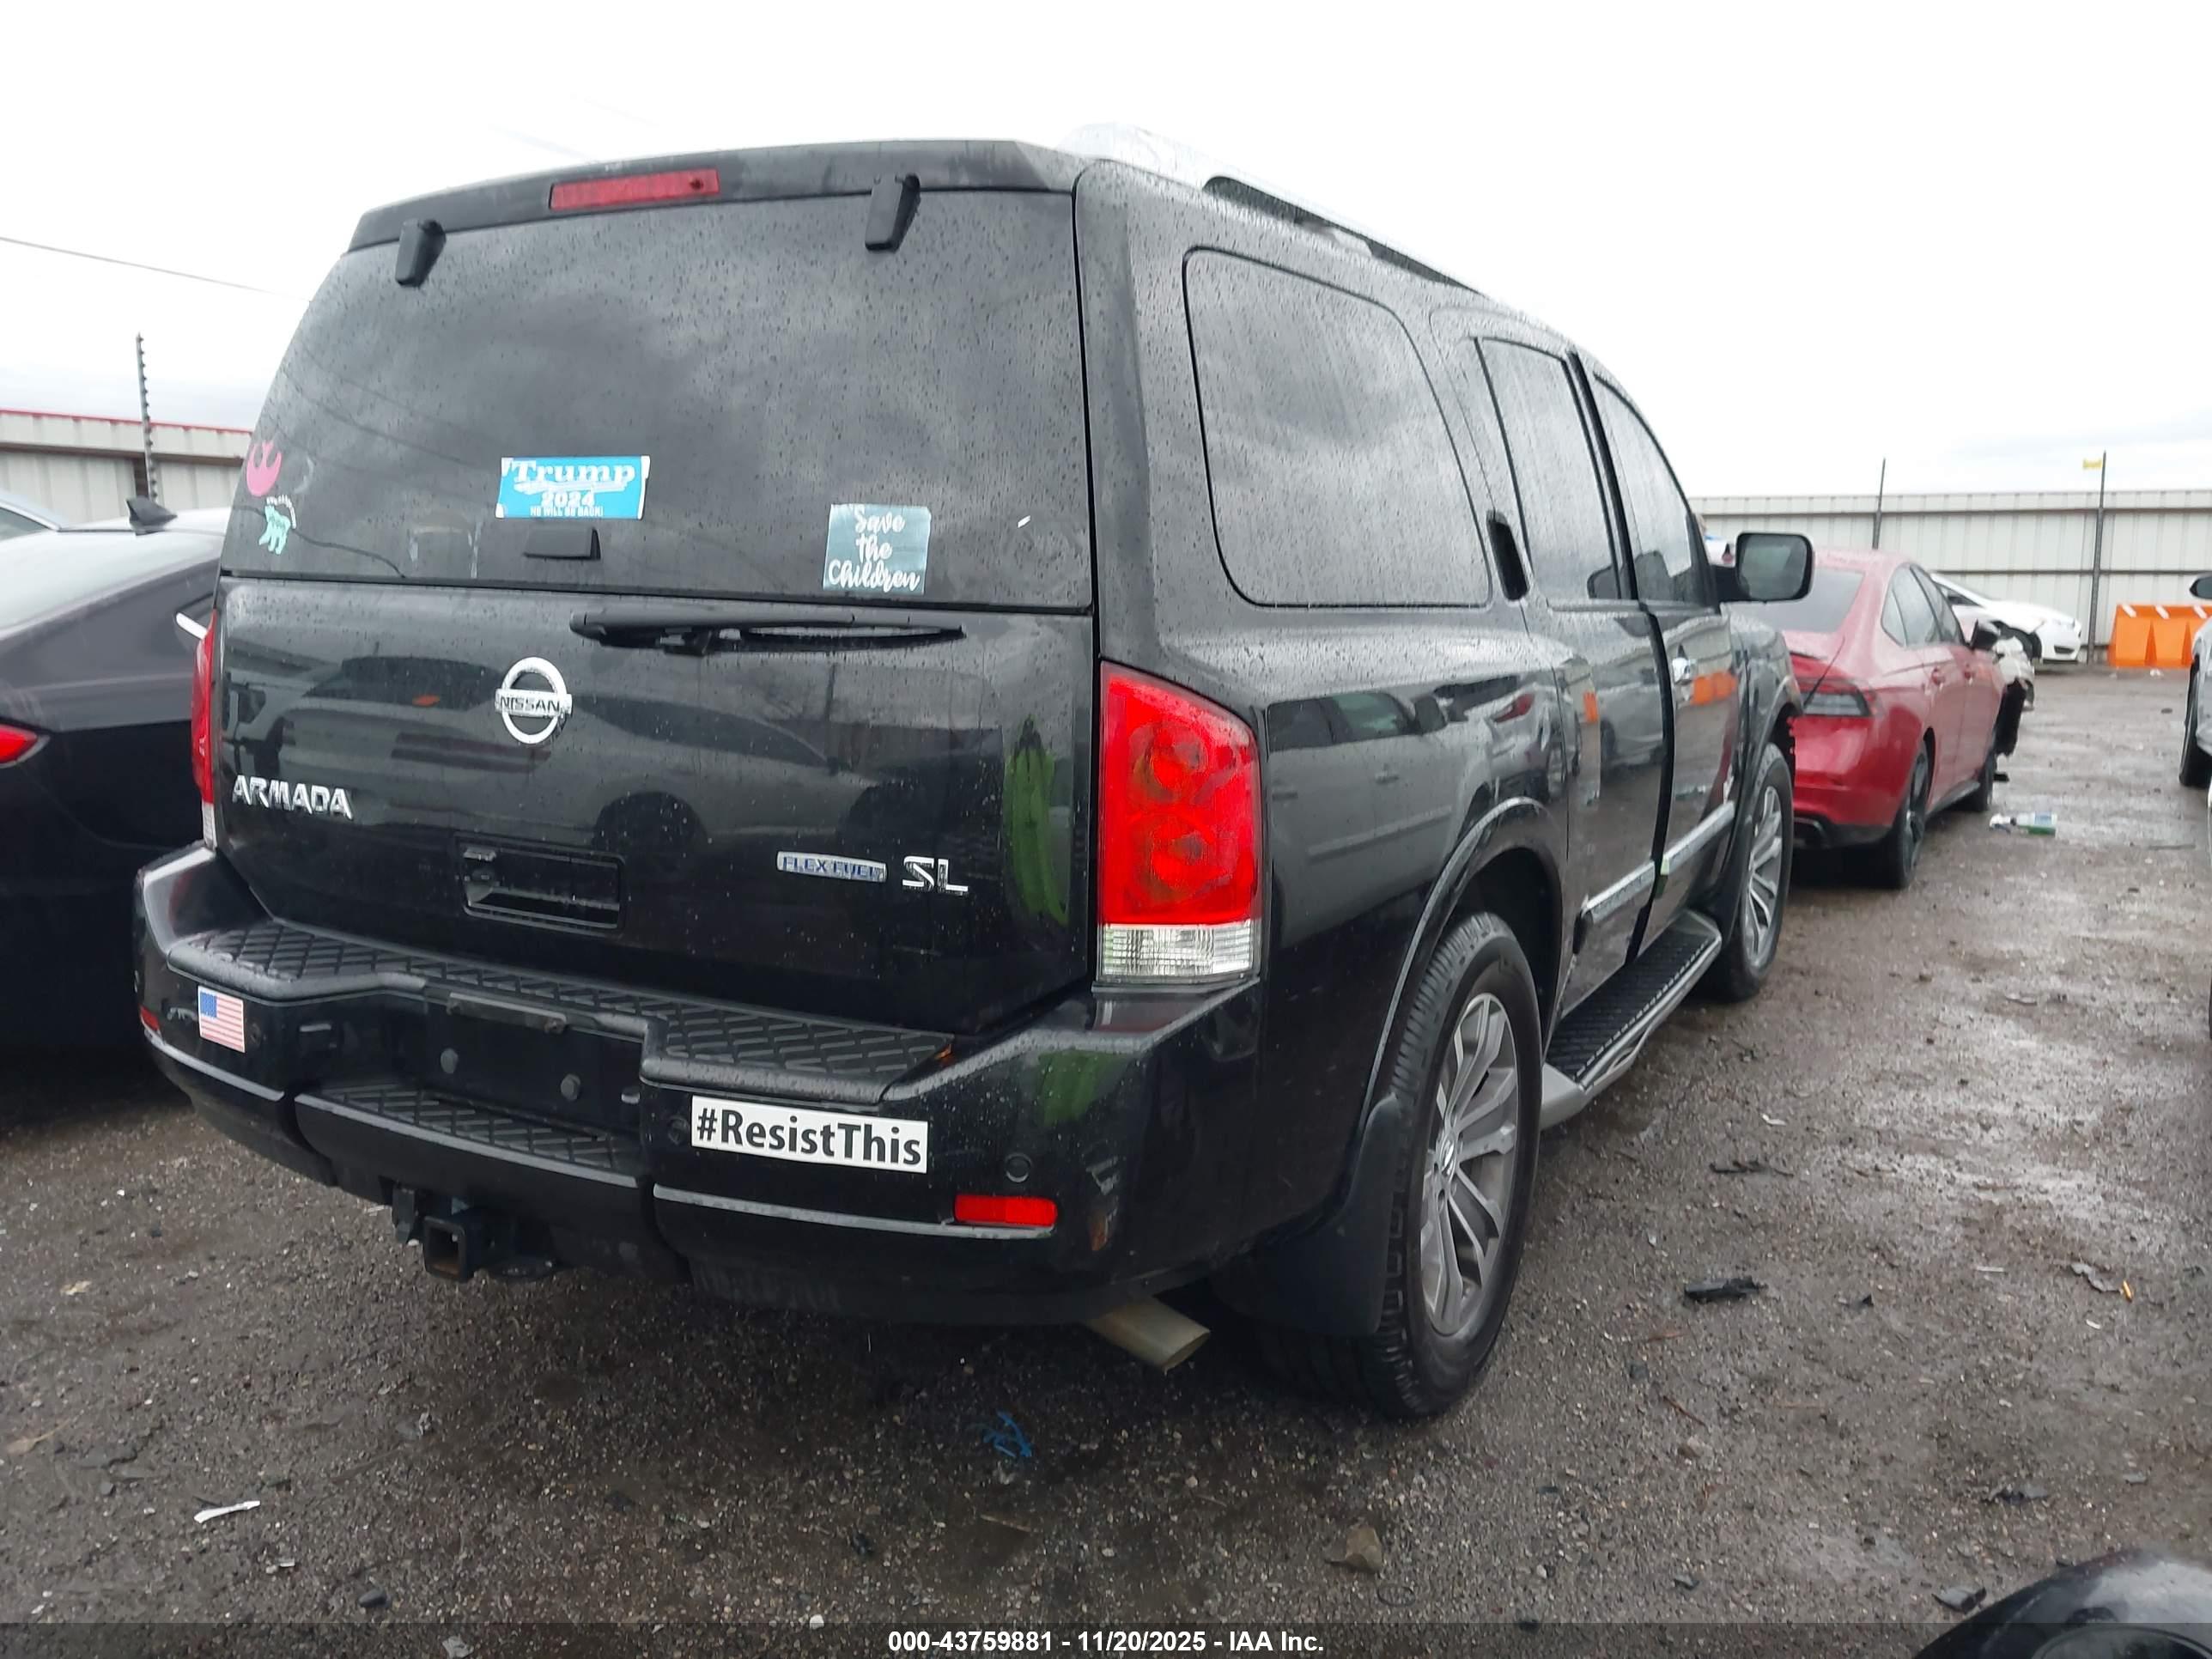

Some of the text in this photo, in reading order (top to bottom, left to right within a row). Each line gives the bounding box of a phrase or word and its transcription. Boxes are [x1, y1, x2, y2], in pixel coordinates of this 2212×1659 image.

[514, 460, 635, 486] Trump
[541, 490, 595, 507] 2024
[854, 505, 905, 534] Save
[828, 559, 921, 592] Children
[501, 696, 560, 712] NISSAN
[232, 775, 354, 821] ARMADA
[902, 855, 969, 895] SL
[696, 1108, 921, 1165] #ResistThis
